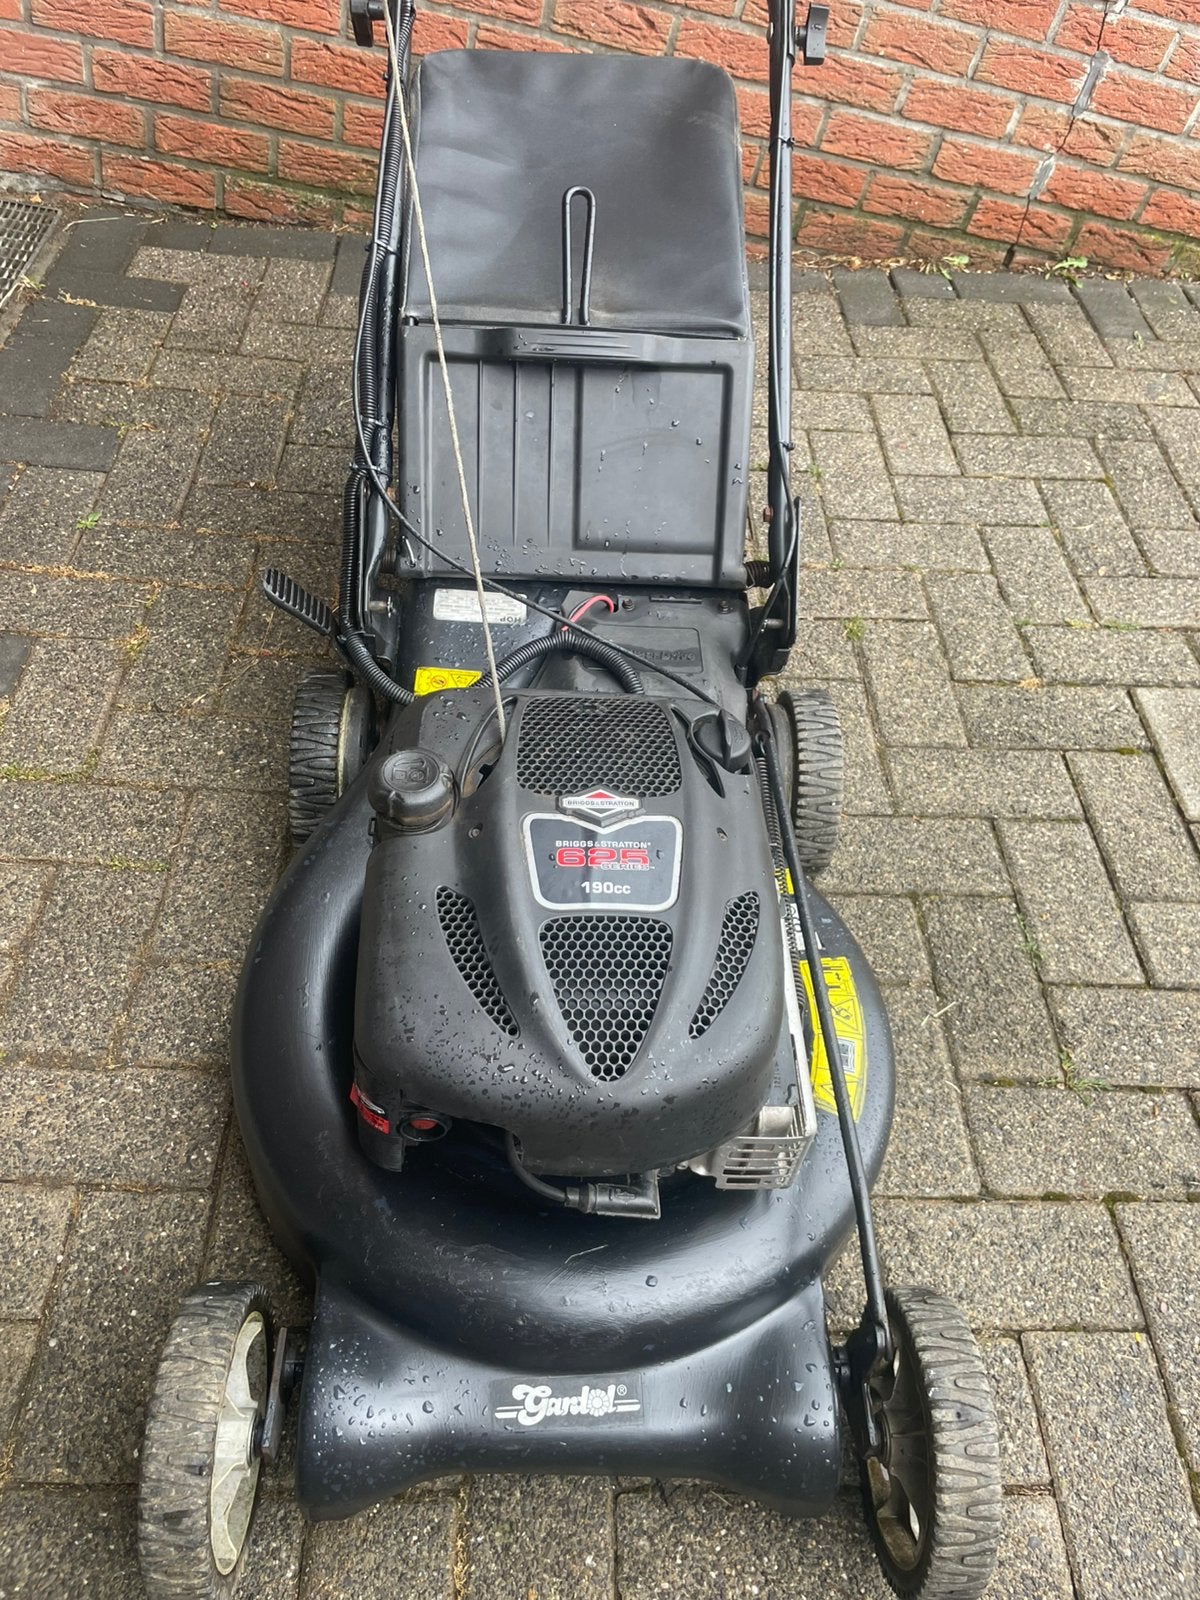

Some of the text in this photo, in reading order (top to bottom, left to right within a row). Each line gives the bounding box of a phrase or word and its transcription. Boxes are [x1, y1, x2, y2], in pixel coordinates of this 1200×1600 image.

[556, 847, 650, 868] 625
[600, 862, 650, 871] SERIES
[581, 881, 632, 895] 190cc
